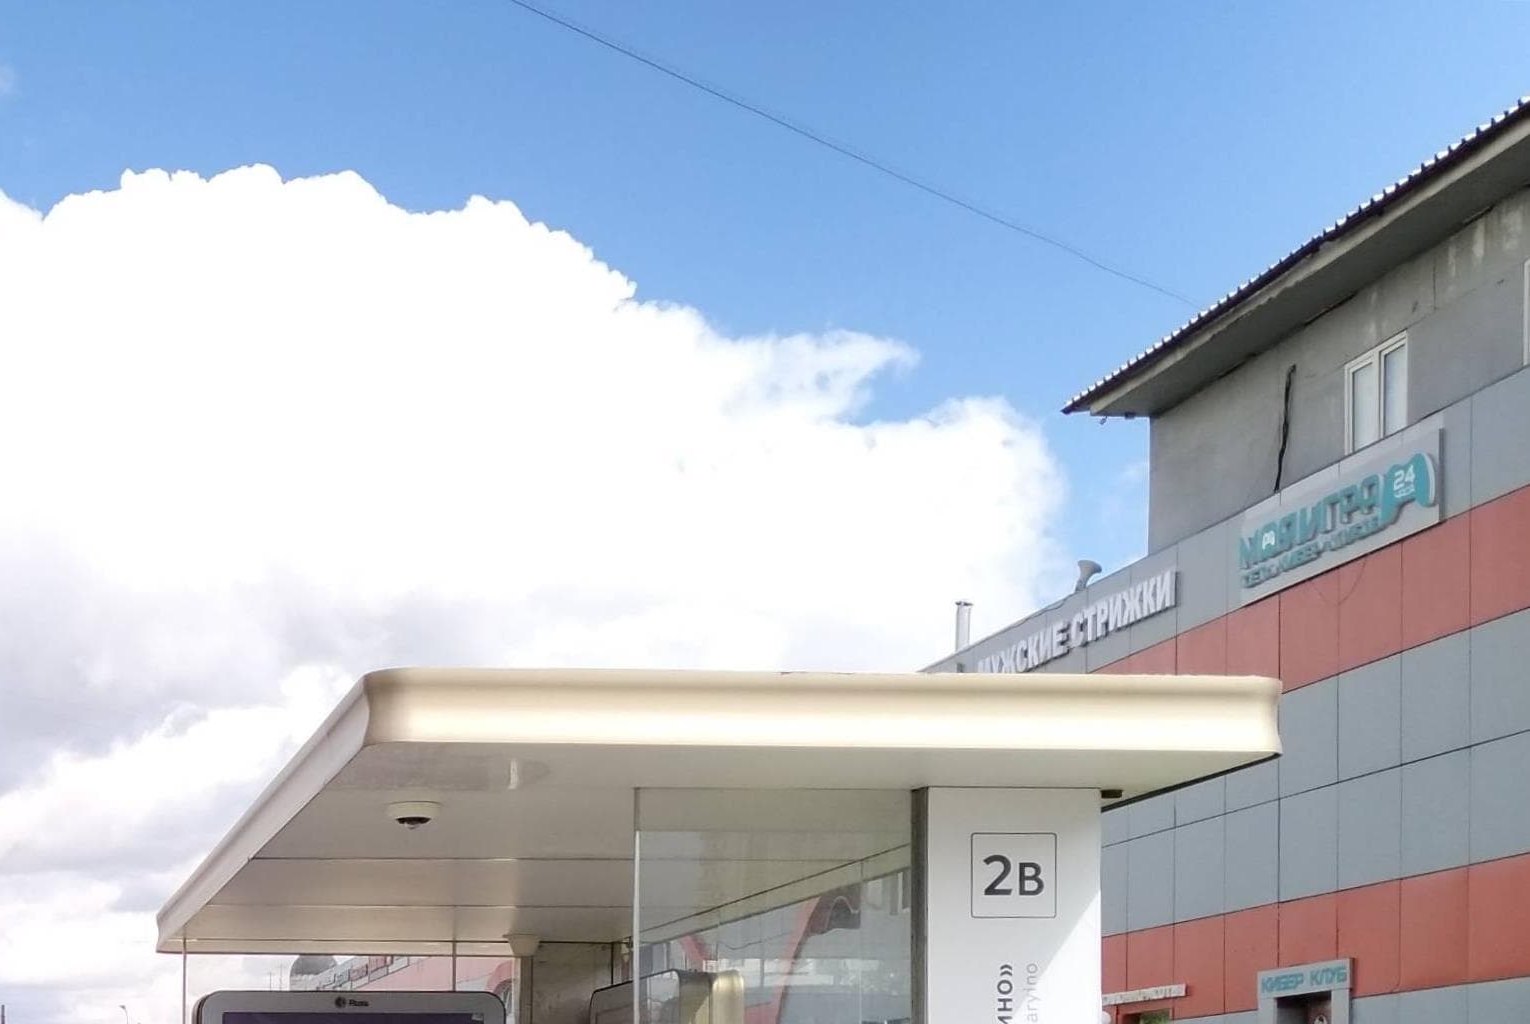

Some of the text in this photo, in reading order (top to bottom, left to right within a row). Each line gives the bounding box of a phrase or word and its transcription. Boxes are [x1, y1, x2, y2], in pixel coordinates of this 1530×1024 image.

[1393, 464, 1416, 491] 24
[1071, 568, 1177, 648] СТРИЖКИ
[1262, 965, 1348, 993] КИБЕР КЛУБ
